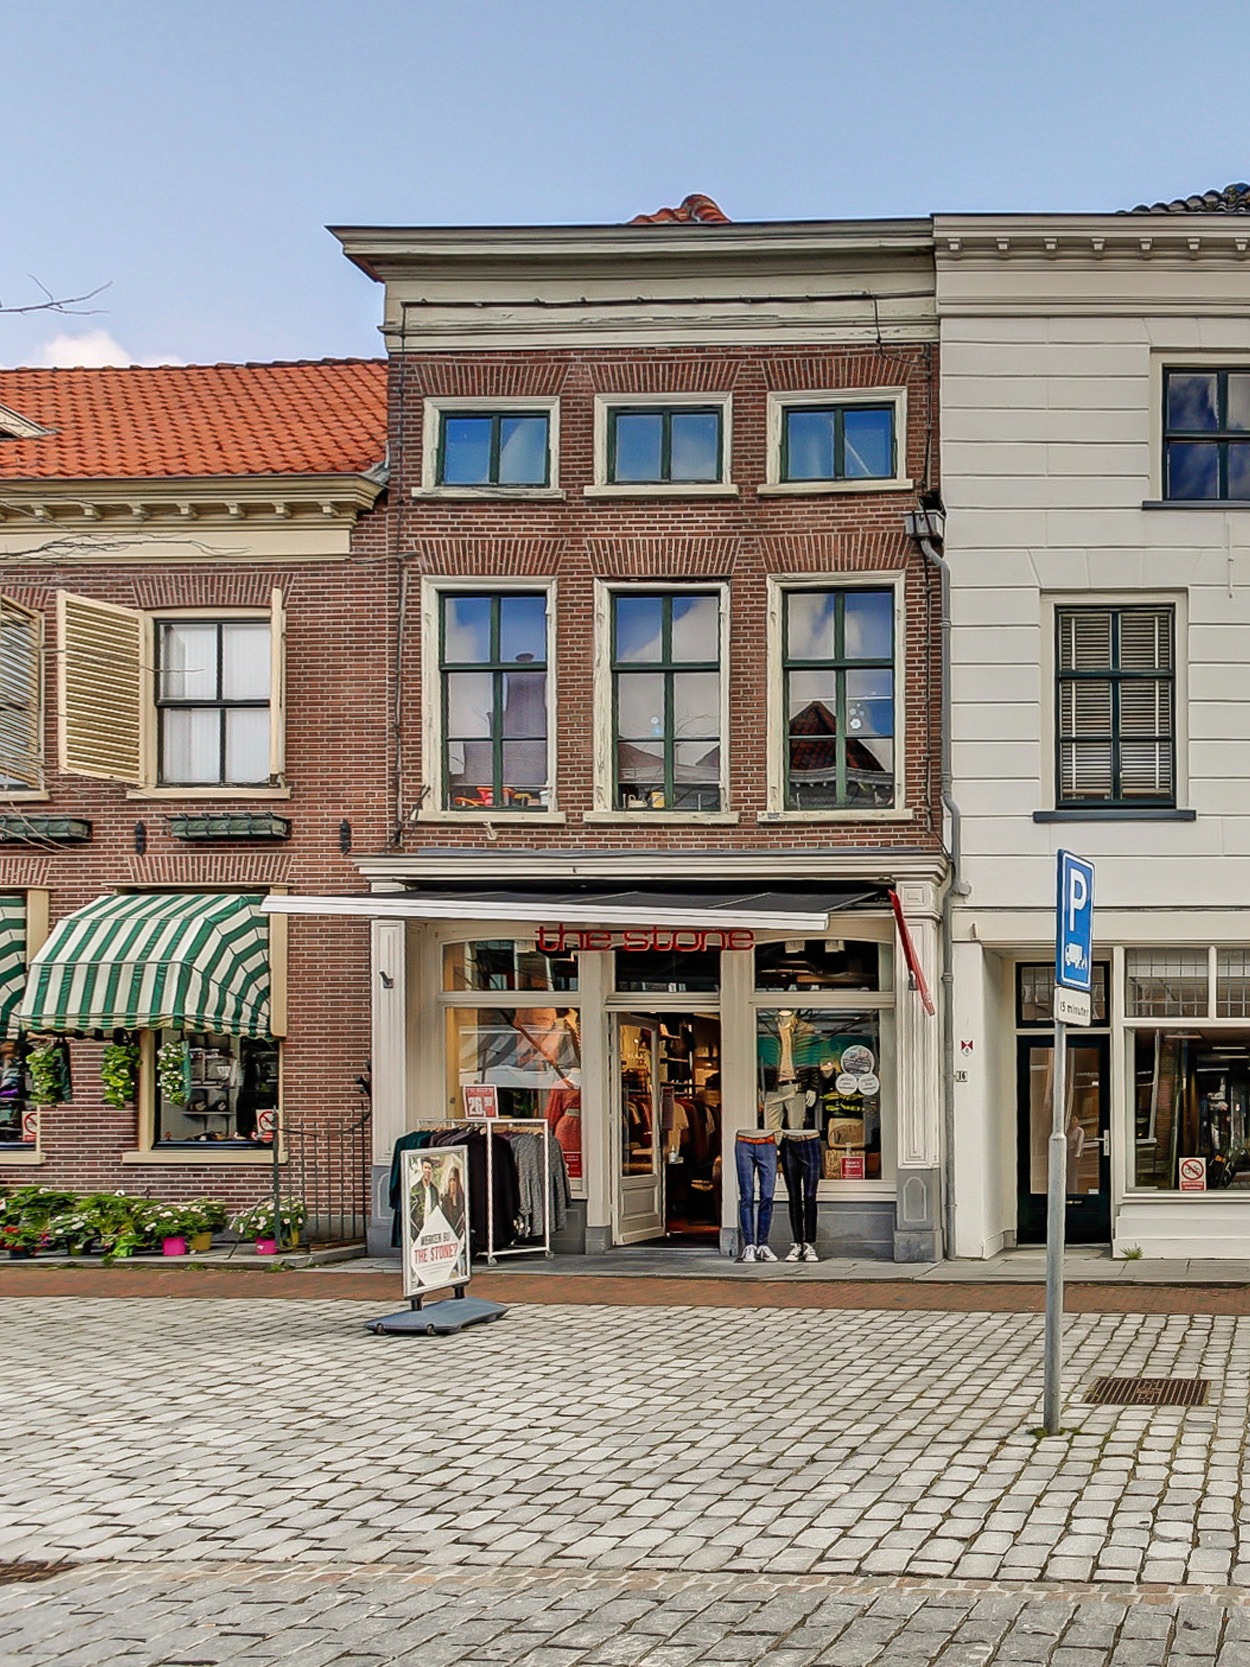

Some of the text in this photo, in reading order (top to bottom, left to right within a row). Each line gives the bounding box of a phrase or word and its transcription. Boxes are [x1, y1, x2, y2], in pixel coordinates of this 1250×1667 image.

[1069, 867, 1088, 932] P
[535, 923, 756, 952] the stone
[1060, 1001, 1066, 1013] 15
[958, 1070, 967, 1080] 16
[414, 1248, 428, 1264] THE
